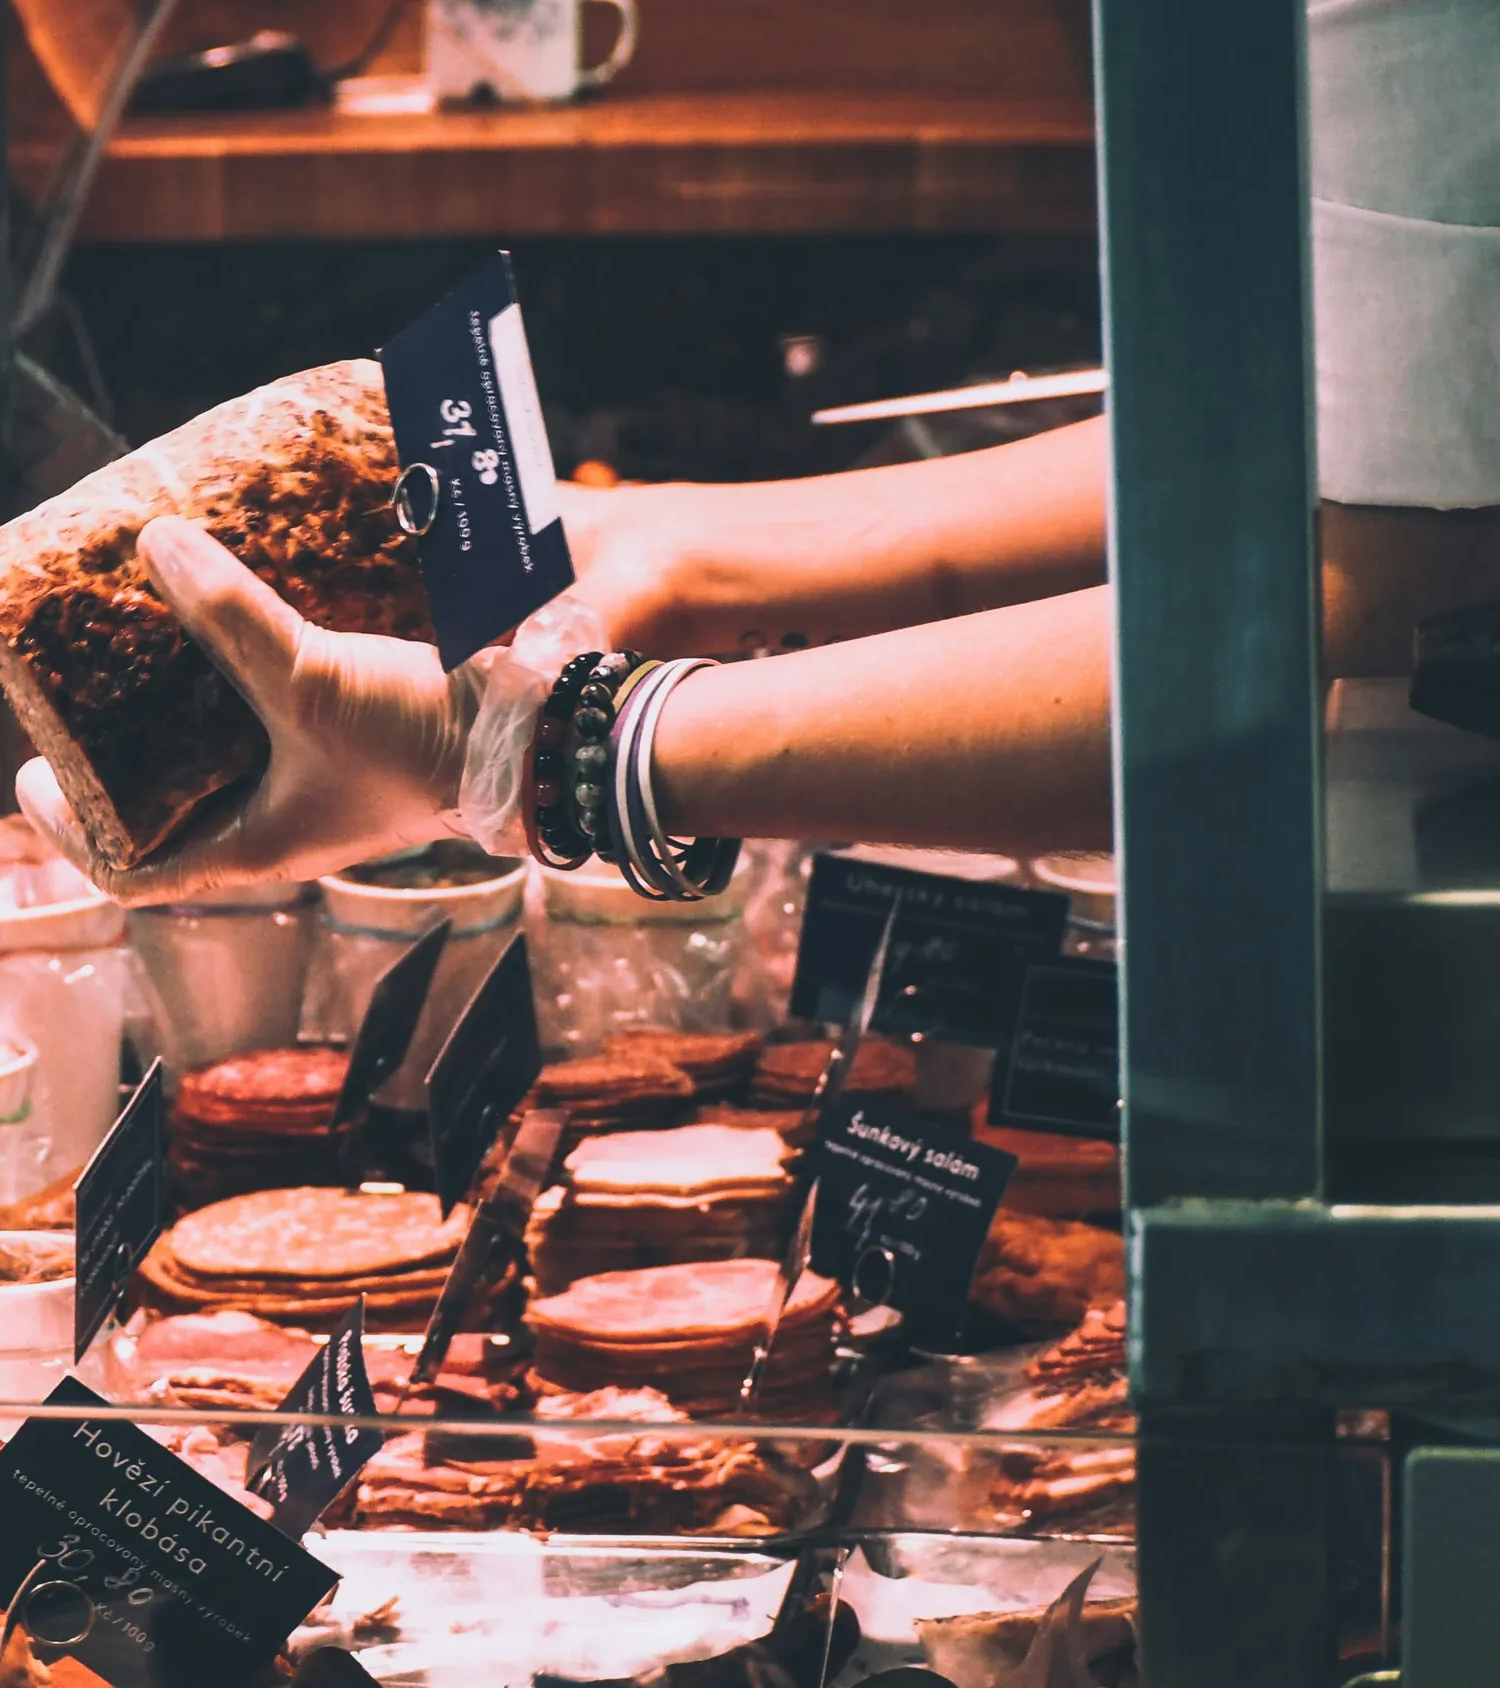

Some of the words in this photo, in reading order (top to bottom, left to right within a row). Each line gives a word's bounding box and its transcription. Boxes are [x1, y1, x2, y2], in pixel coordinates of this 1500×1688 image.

[923, 1148, 980, 1181] salám
[73, 1420, 171, 1498] Hovězí
[165, 1497, 290, 1582] pikantní
[99, 1488, 206, 1574] klobása
[68, 1510, 149, 1571] opracovaný
